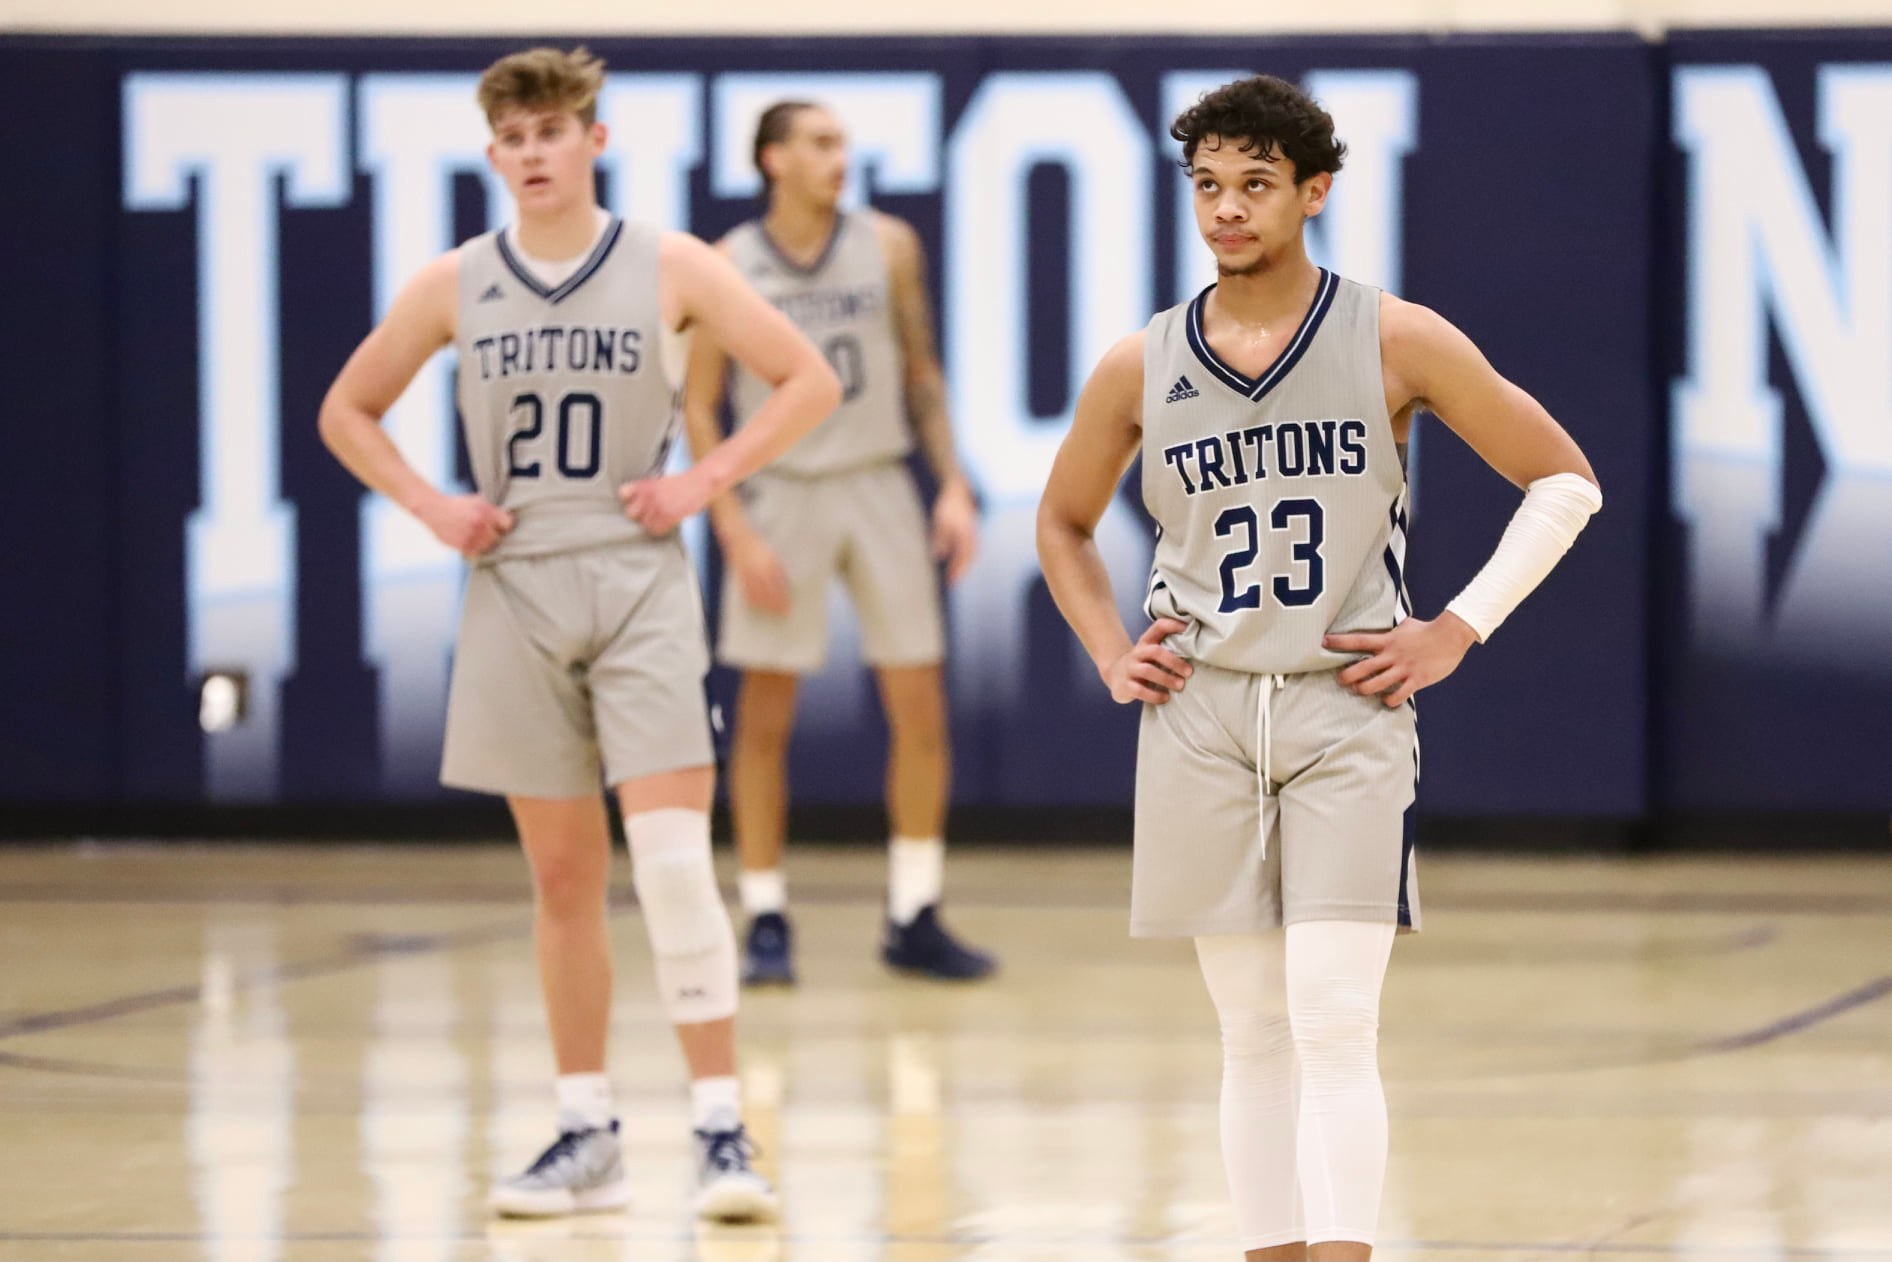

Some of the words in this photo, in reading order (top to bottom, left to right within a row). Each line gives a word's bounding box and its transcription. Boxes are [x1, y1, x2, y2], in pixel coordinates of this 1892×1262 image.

[473, 327, 642, 379] TRITONS
[508, 392, 603, 479] 20
[1166, 389, 1200, 404] adidas
[1162, 418, 1369, 496] TRITONS
[1213, 497, 1326, 614] 23
